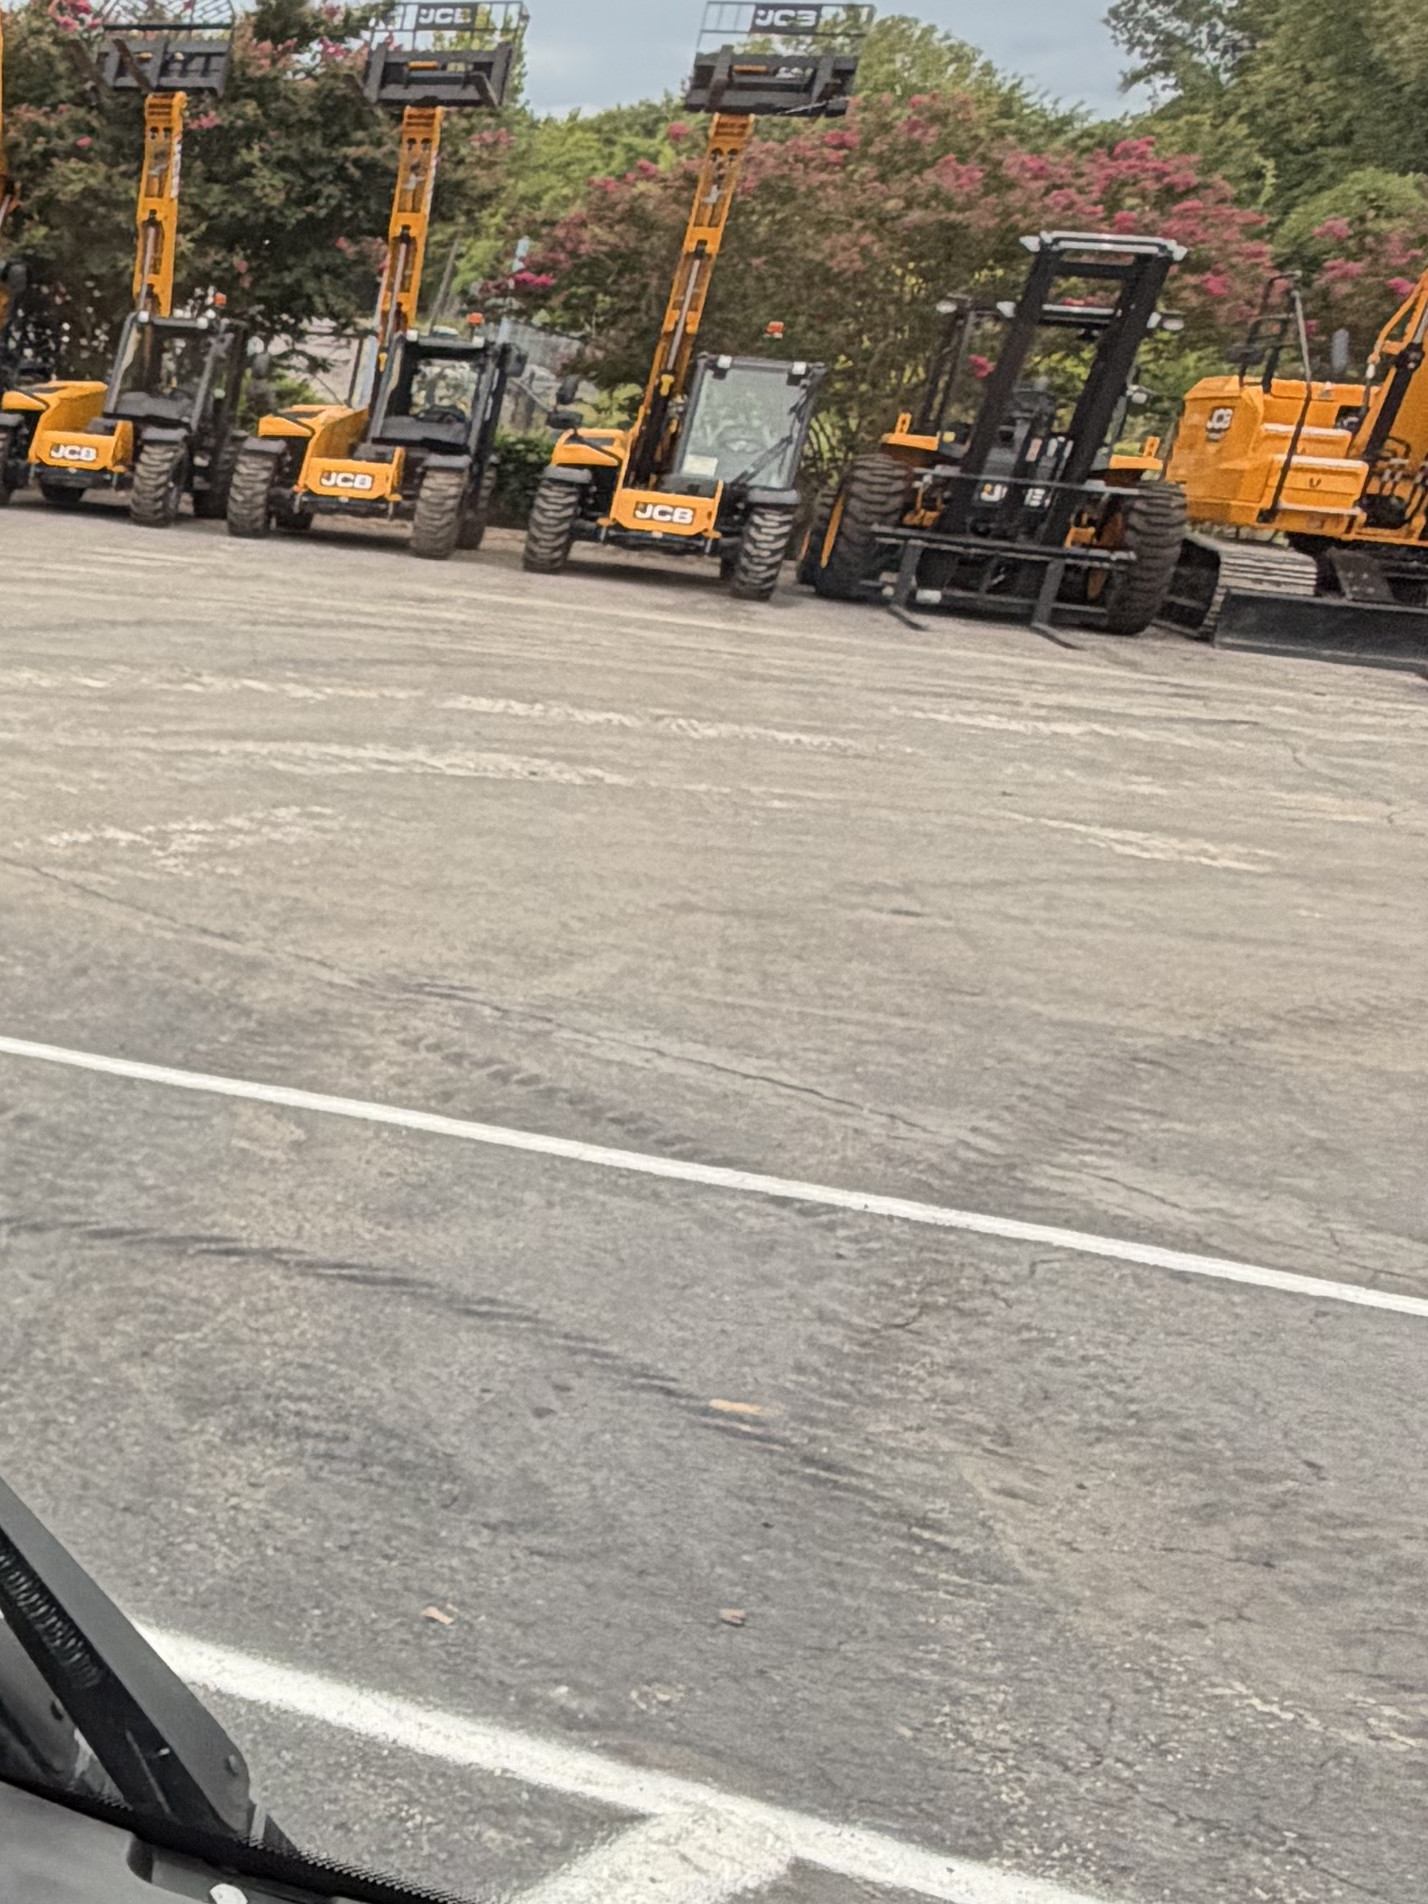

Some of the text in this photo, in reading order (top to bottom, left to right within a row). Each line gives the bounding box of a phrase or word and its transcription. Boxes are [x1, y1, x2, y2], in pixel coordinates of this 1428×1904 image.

[418, 7, 472, 24] JCB
[755, 9, 818, 27] JCB
[49, 443, 97, 462] JCB
[321, 471, 373, 490] JCB
[634, 503, 694, 525] JCB
